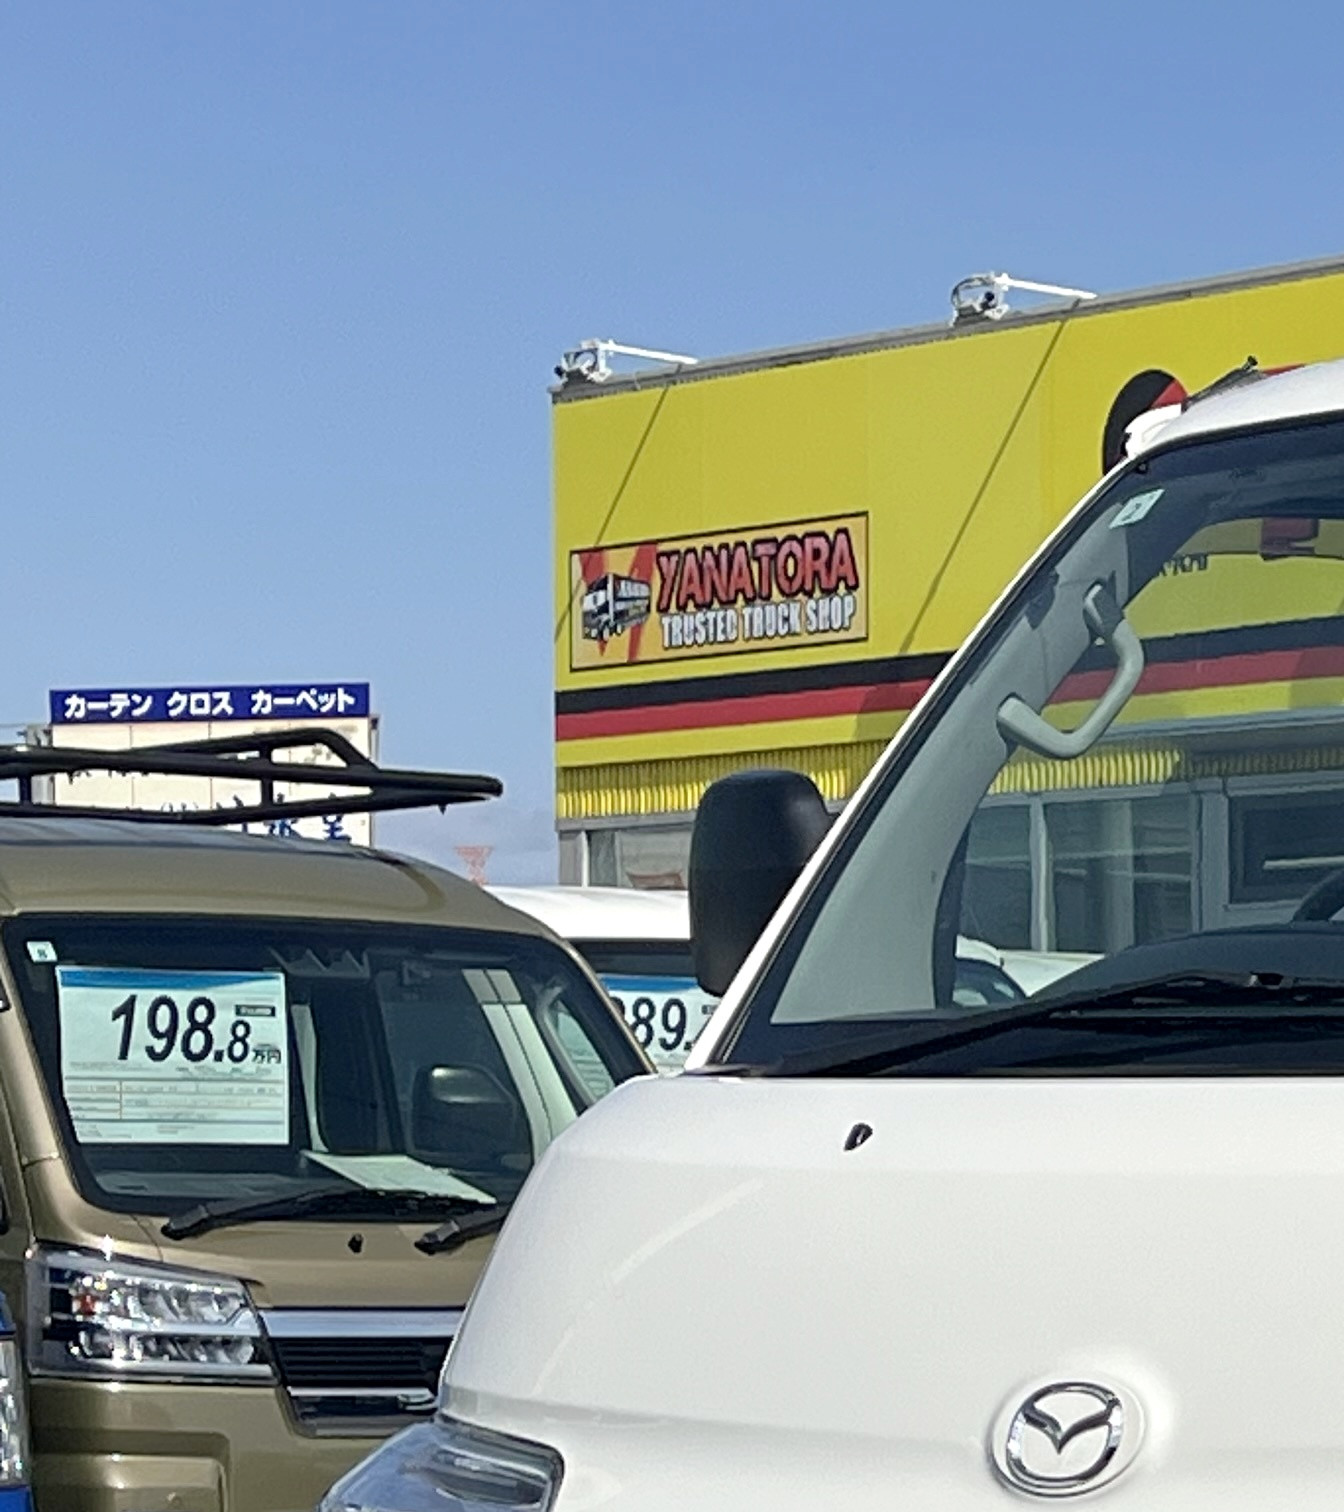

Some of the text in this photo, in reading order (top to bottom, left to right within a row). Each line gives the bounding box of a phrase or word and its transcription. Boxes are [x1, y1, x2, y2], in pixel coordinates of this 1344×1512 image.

[656, 528, 859, 612] YANATORA
[661, 592, 857, 650] TRUSTED TRUCK SHOP
[64, 686, 356, 719] カーテン クロス カーペット
